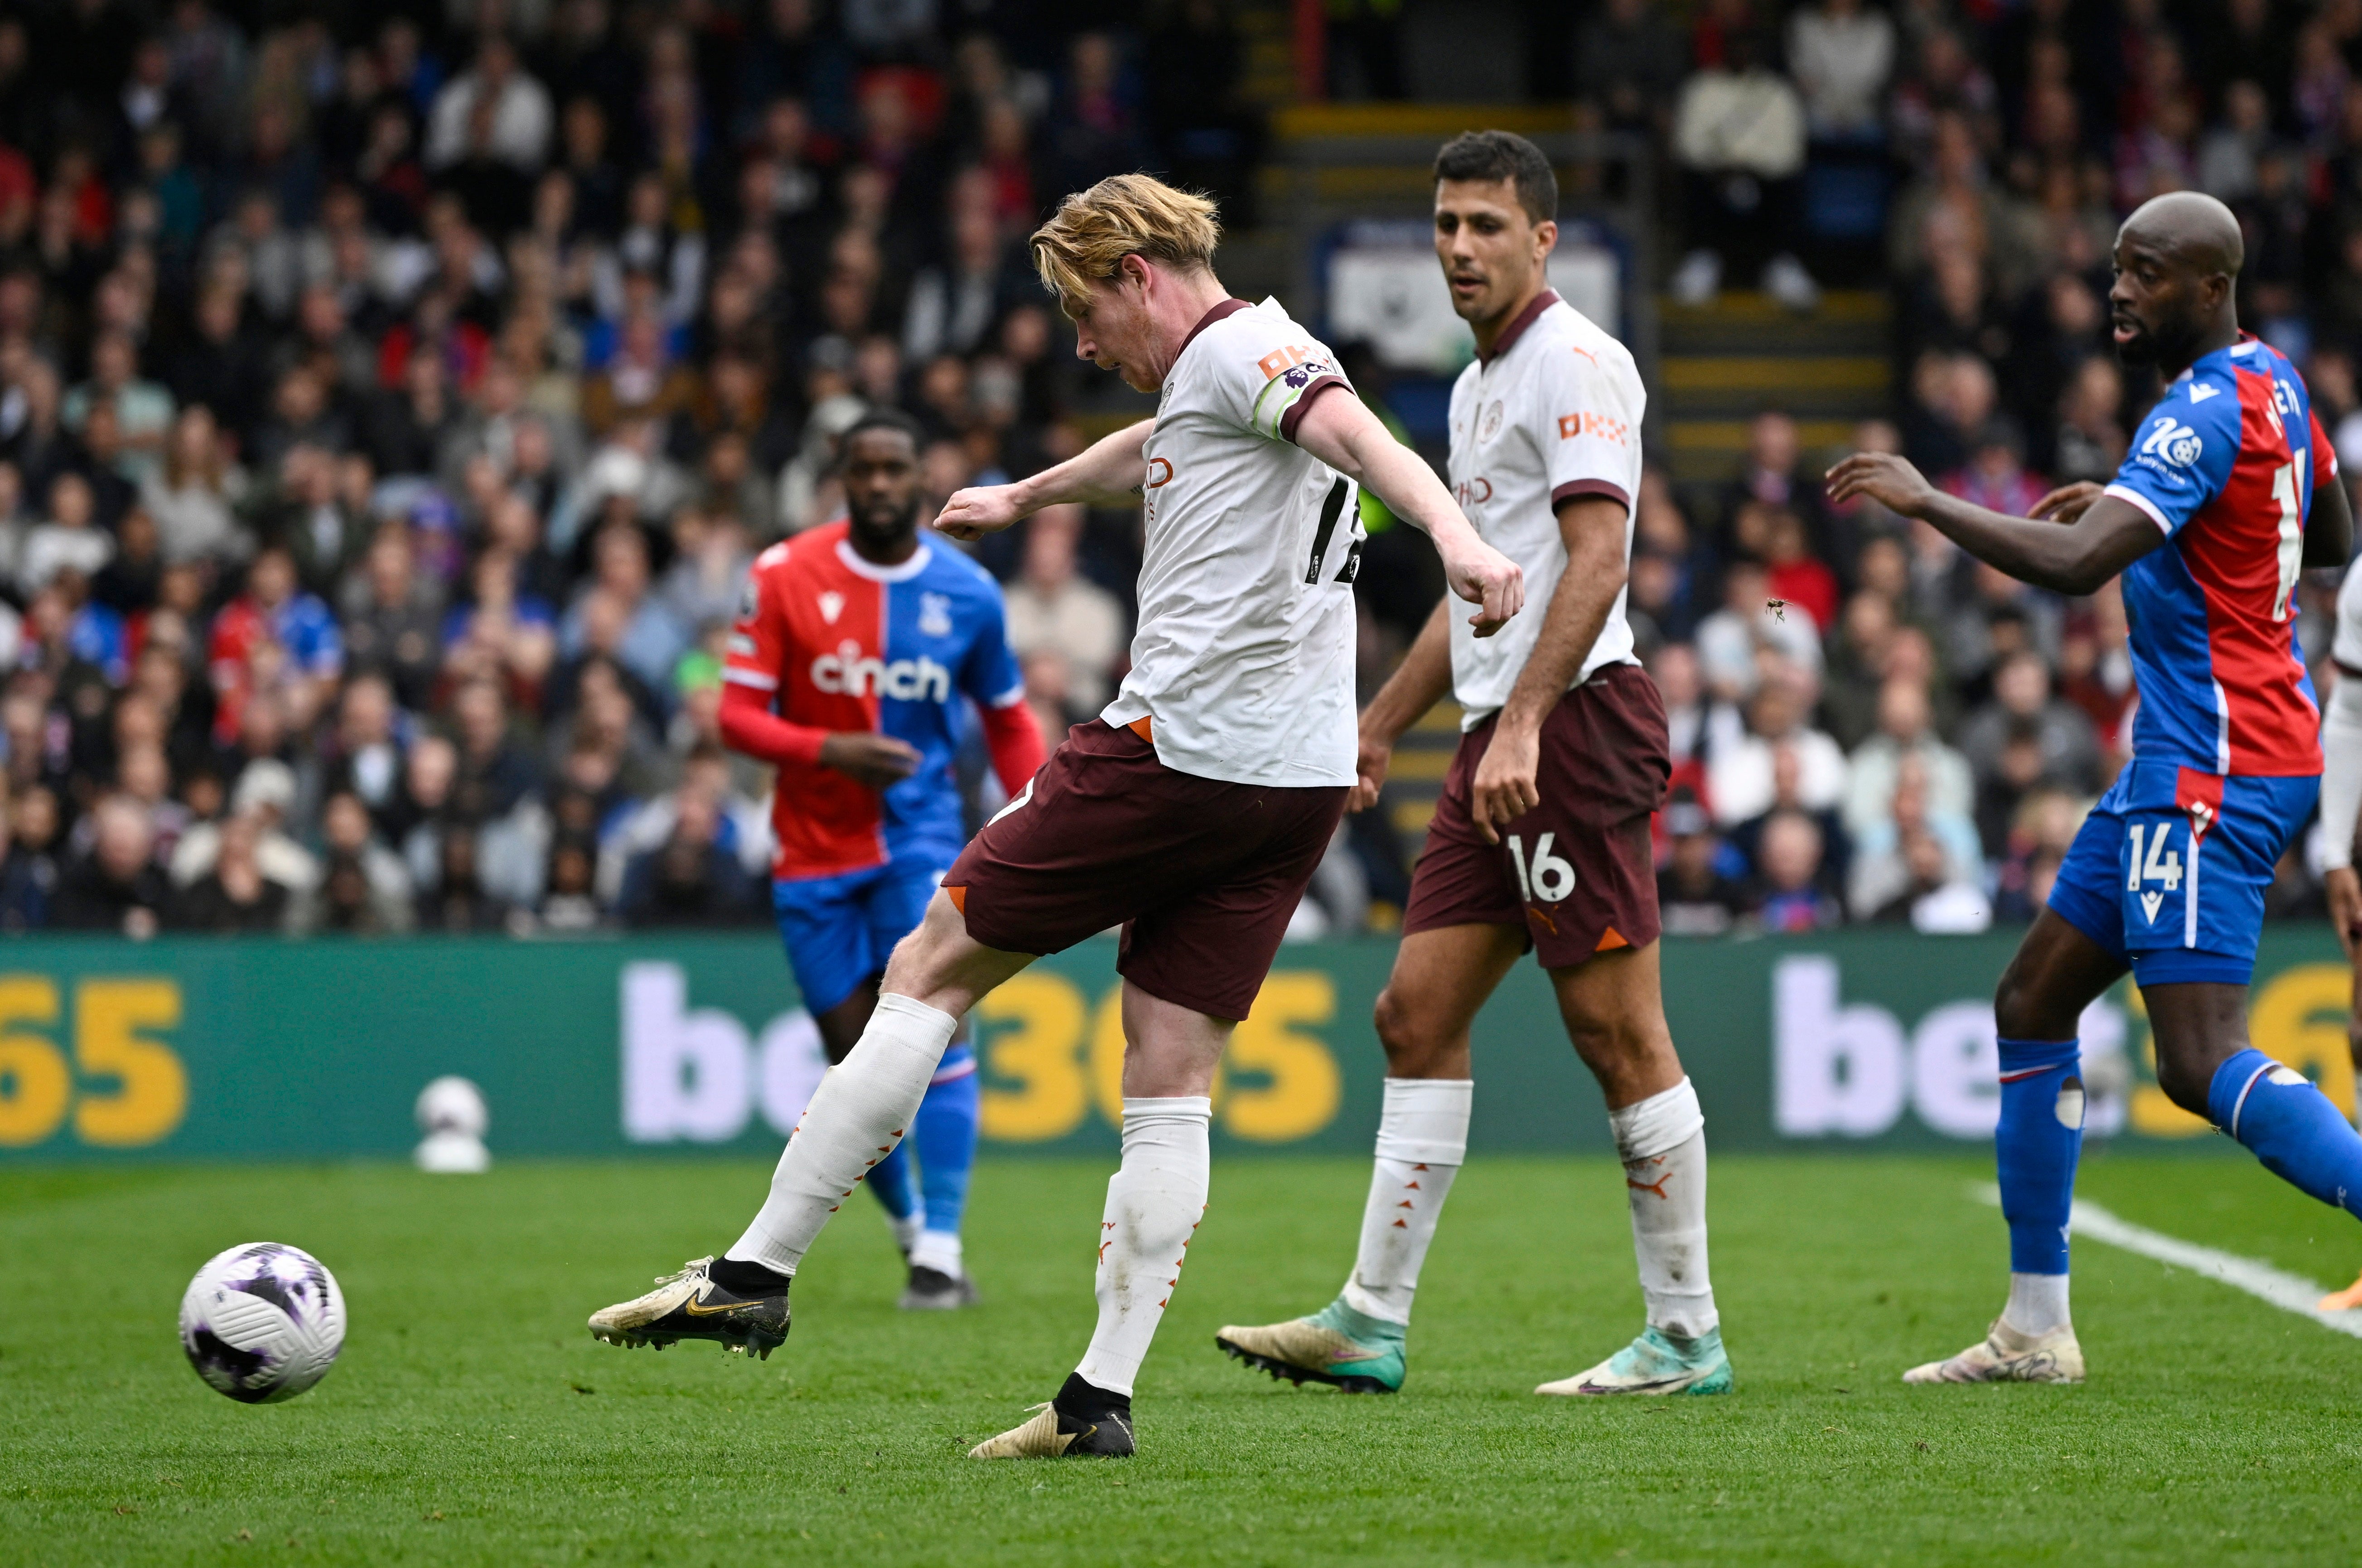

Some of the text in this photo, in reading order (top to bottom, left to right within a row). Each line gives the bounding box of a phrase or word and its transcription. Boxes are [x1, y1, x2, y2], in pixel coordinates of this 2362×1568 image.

[810, 638, 951, 704] cinch
[1508, 832, 1576, 902] 16
[2127, 822, 2183, 892] 14
